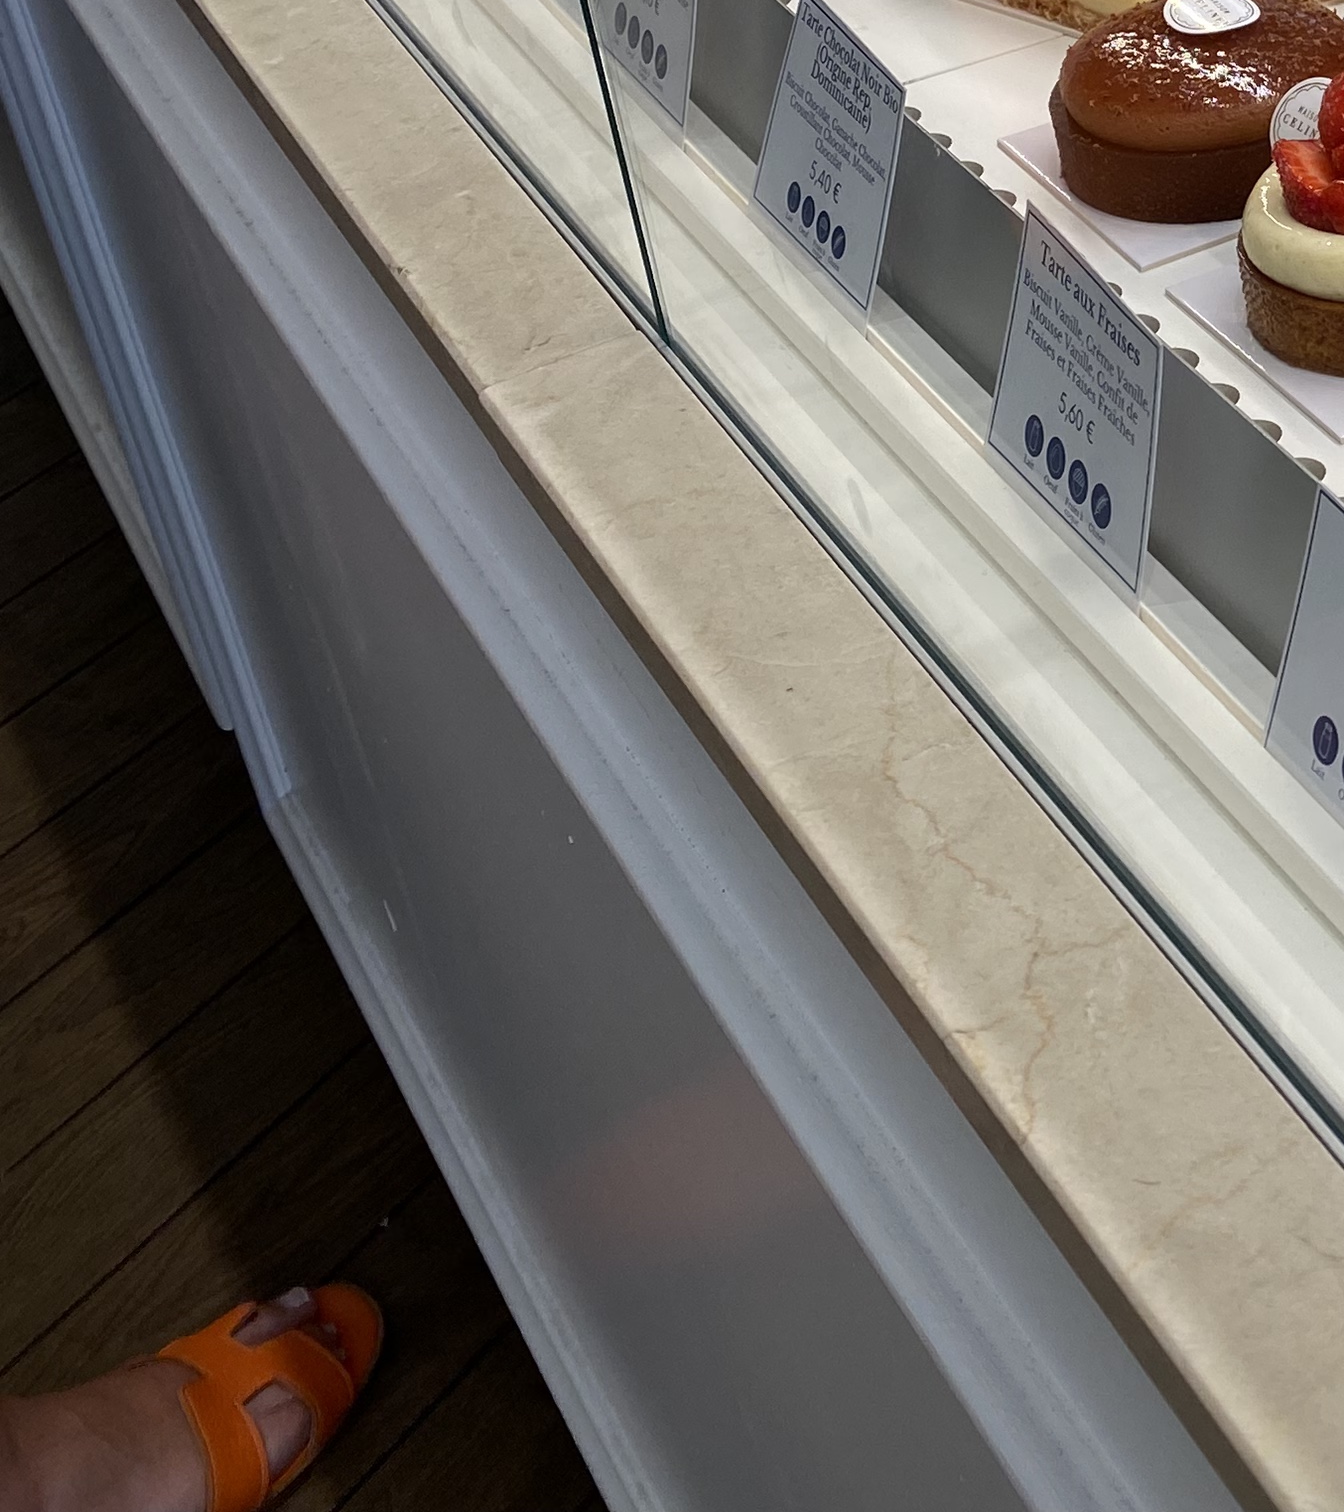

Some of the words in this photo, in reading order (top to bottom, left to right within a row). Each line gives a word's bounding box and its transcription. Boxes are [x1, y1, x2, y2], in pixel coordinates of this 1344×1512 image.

[801, 1, 823, 38] Tarte
[823, 26, 860, 76] Chocolat
[860, 61, 883, 98] Noir
[883, 81, 898, 115] Bio
[810, 58, 872, 135] Dominicaine)
[816, 41, 852, 91] (Origine
[853, 77, 873, 112] Rep.
[1283, 113, 1319, 139] CELIN
[1297, 105, 1319, 122] MAISO
[809, 159, 832, 195] 5,40
[832, 182, 842, 205] €
[1040, 239, 1072, 292] Tarte
[1073, 283, 1096, 319] aux
[1097, 299, 1141, 367] Fraises
[1023, 267, 1053, 310] Biscuit
[1053, 296, 1084, 347] Vanille,
[1086, 334, 1116, 377] Crème
[1116, 364, 1151, 419] Vanille,
[1024, 318, 1056, 362] Fraises
[1056, 354, 1066, 371] et
[1066, 360, 1097, 408] Fraises
[1030, 298, 1063, 344] Mousse
[1064, 332, 1095, 383] Vanille,
[1096, 369, 1126, 412] Confit
[1126, 402, 1139, 425] de
[1058, 391, 1084, 432] 5,60
[1086, 420, 1096, 445] €
